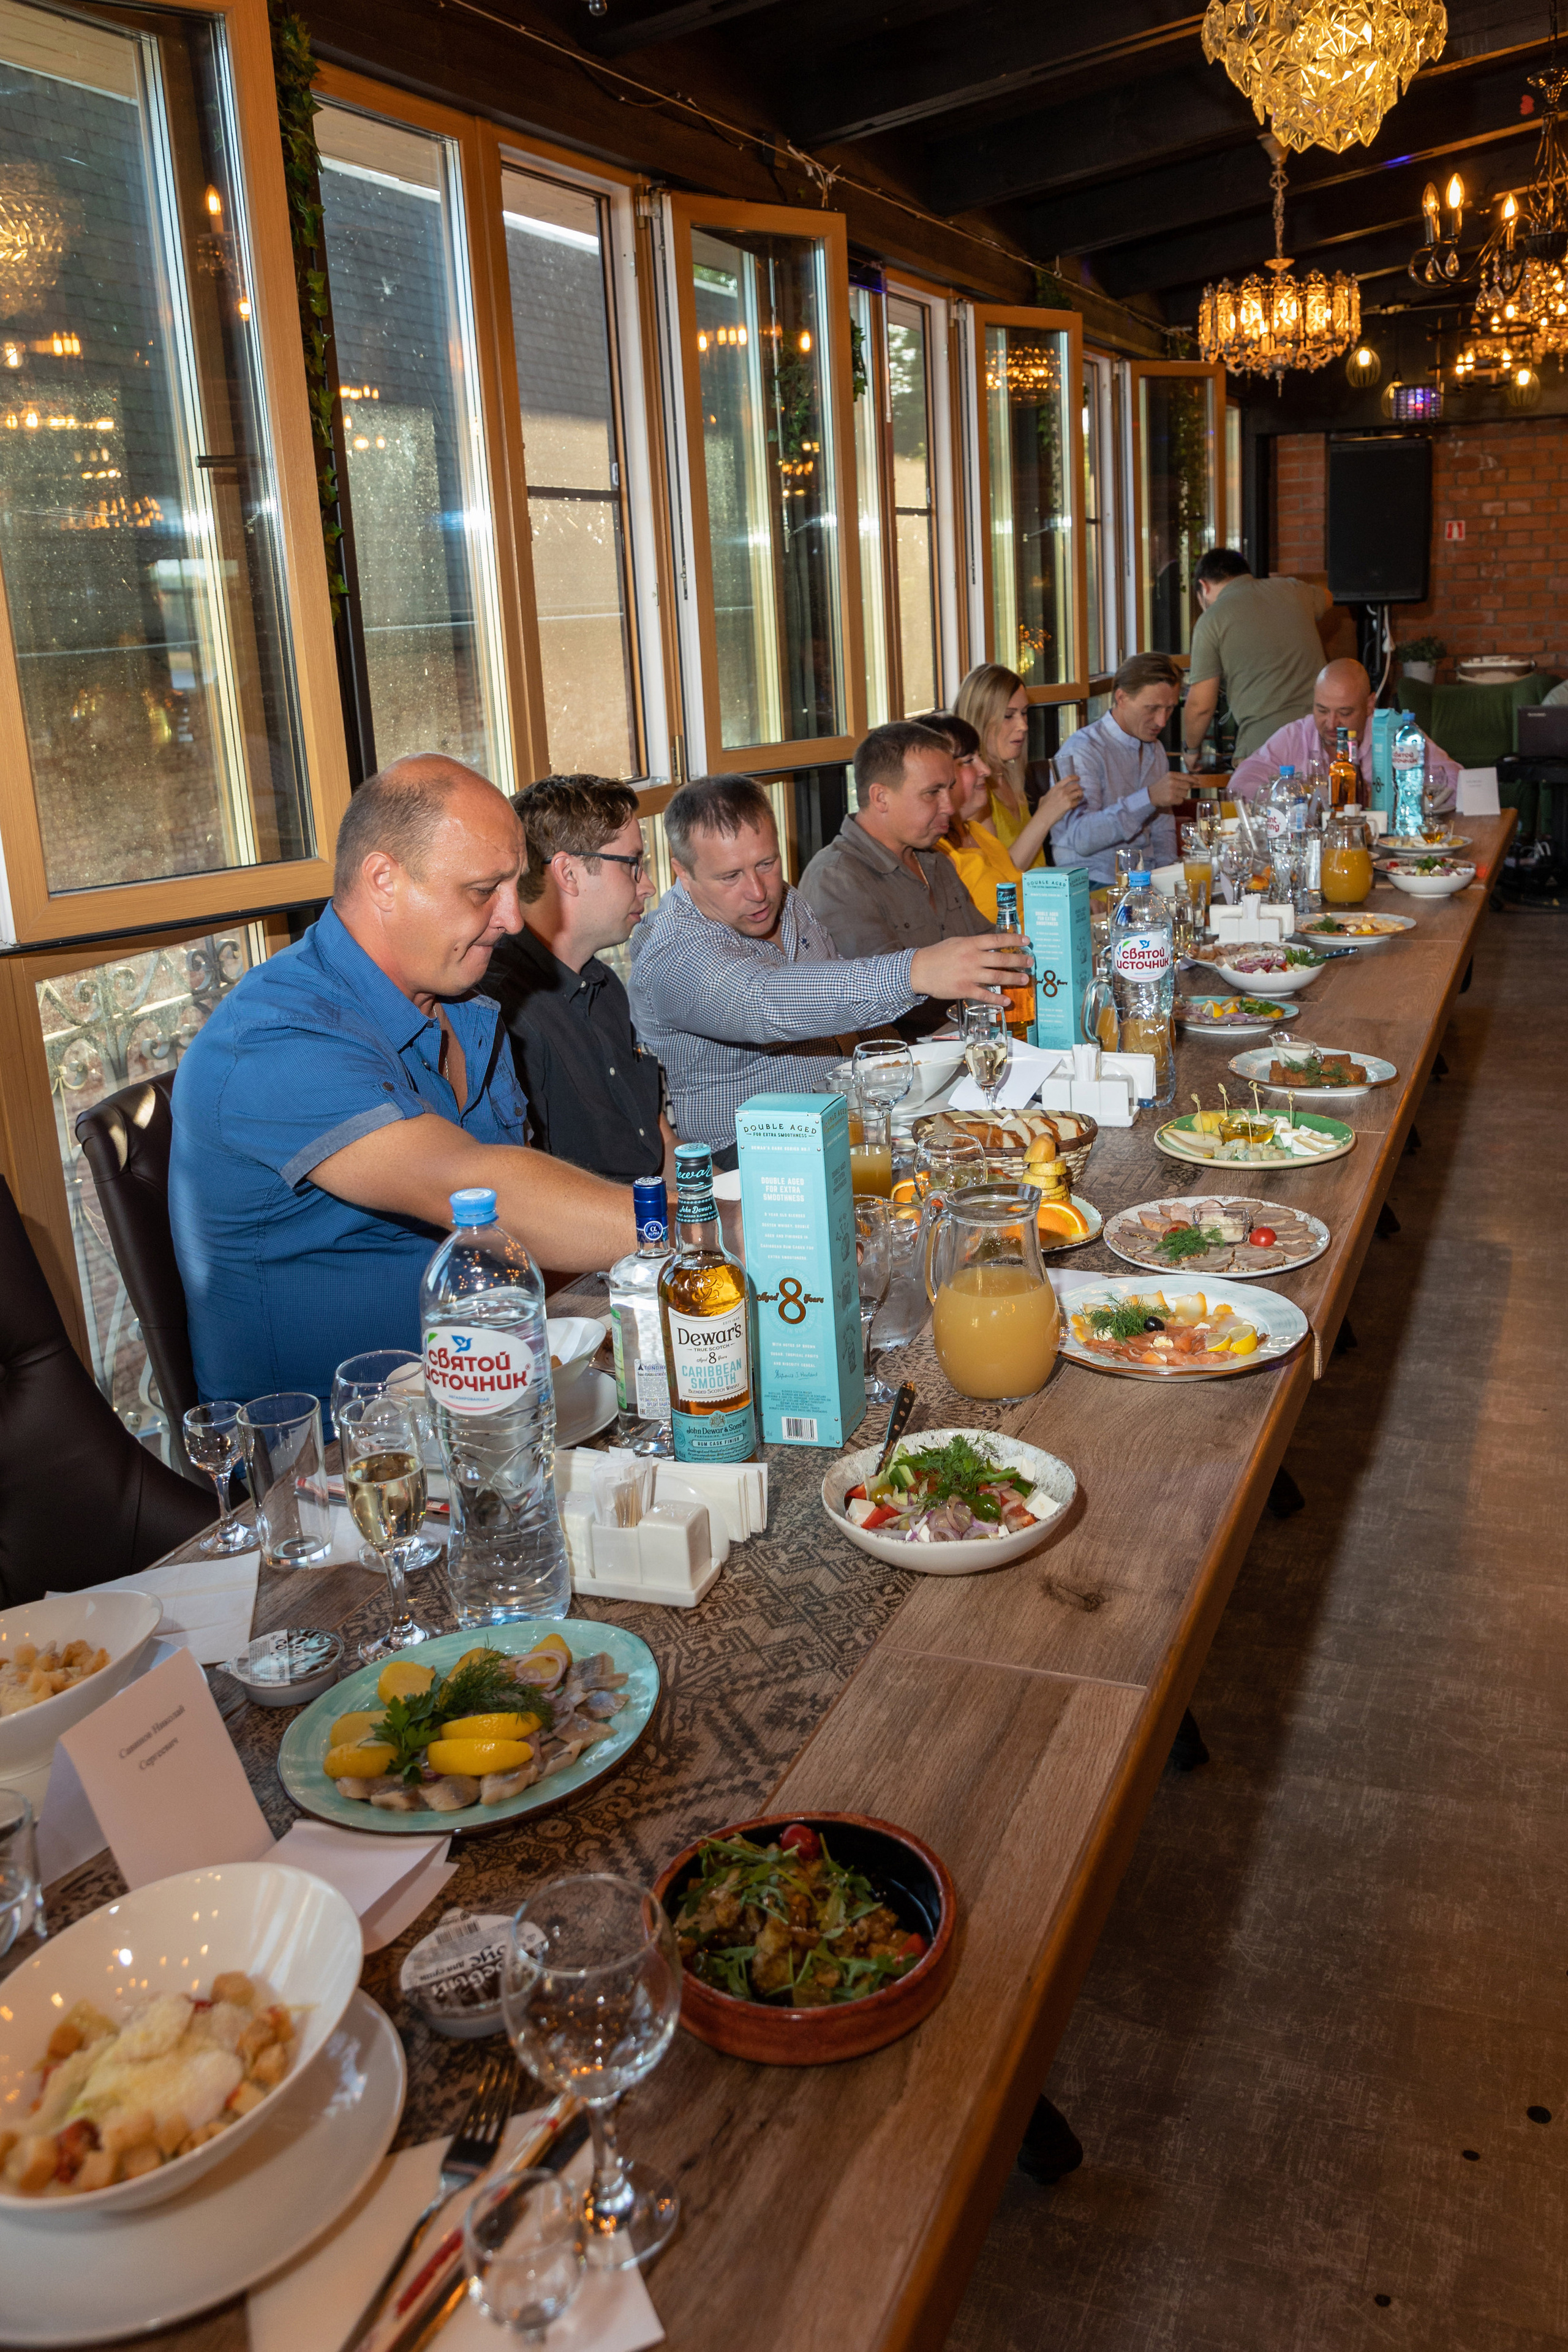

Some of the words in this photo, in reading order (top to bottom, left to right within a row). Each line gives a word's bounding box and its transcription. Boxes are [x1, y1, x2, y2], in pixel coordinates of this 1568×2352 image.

[1043, 970, 1058, 997] 8
[744, 1123, 784, 1133] DOUBLE
[790, 1125, 816, 1134] AGED
[756, 1292, 779, 1303] Aged
[778, 1277, 806, 1324] 8
[804, 1293, 824, 1304] Years
[677, 1323, 742, 1346] Dewar's
[682, 1358, 742, 1378] CARIBBEAN
[709, 1352, 717, 1364] 8
[691, 1373, 736, 1389] SMOOTH
[728, 1422, 742, 1431] Sons
[469, 1944, 506, 1967] оус
[431, 1961, 505, 1997] оевый
